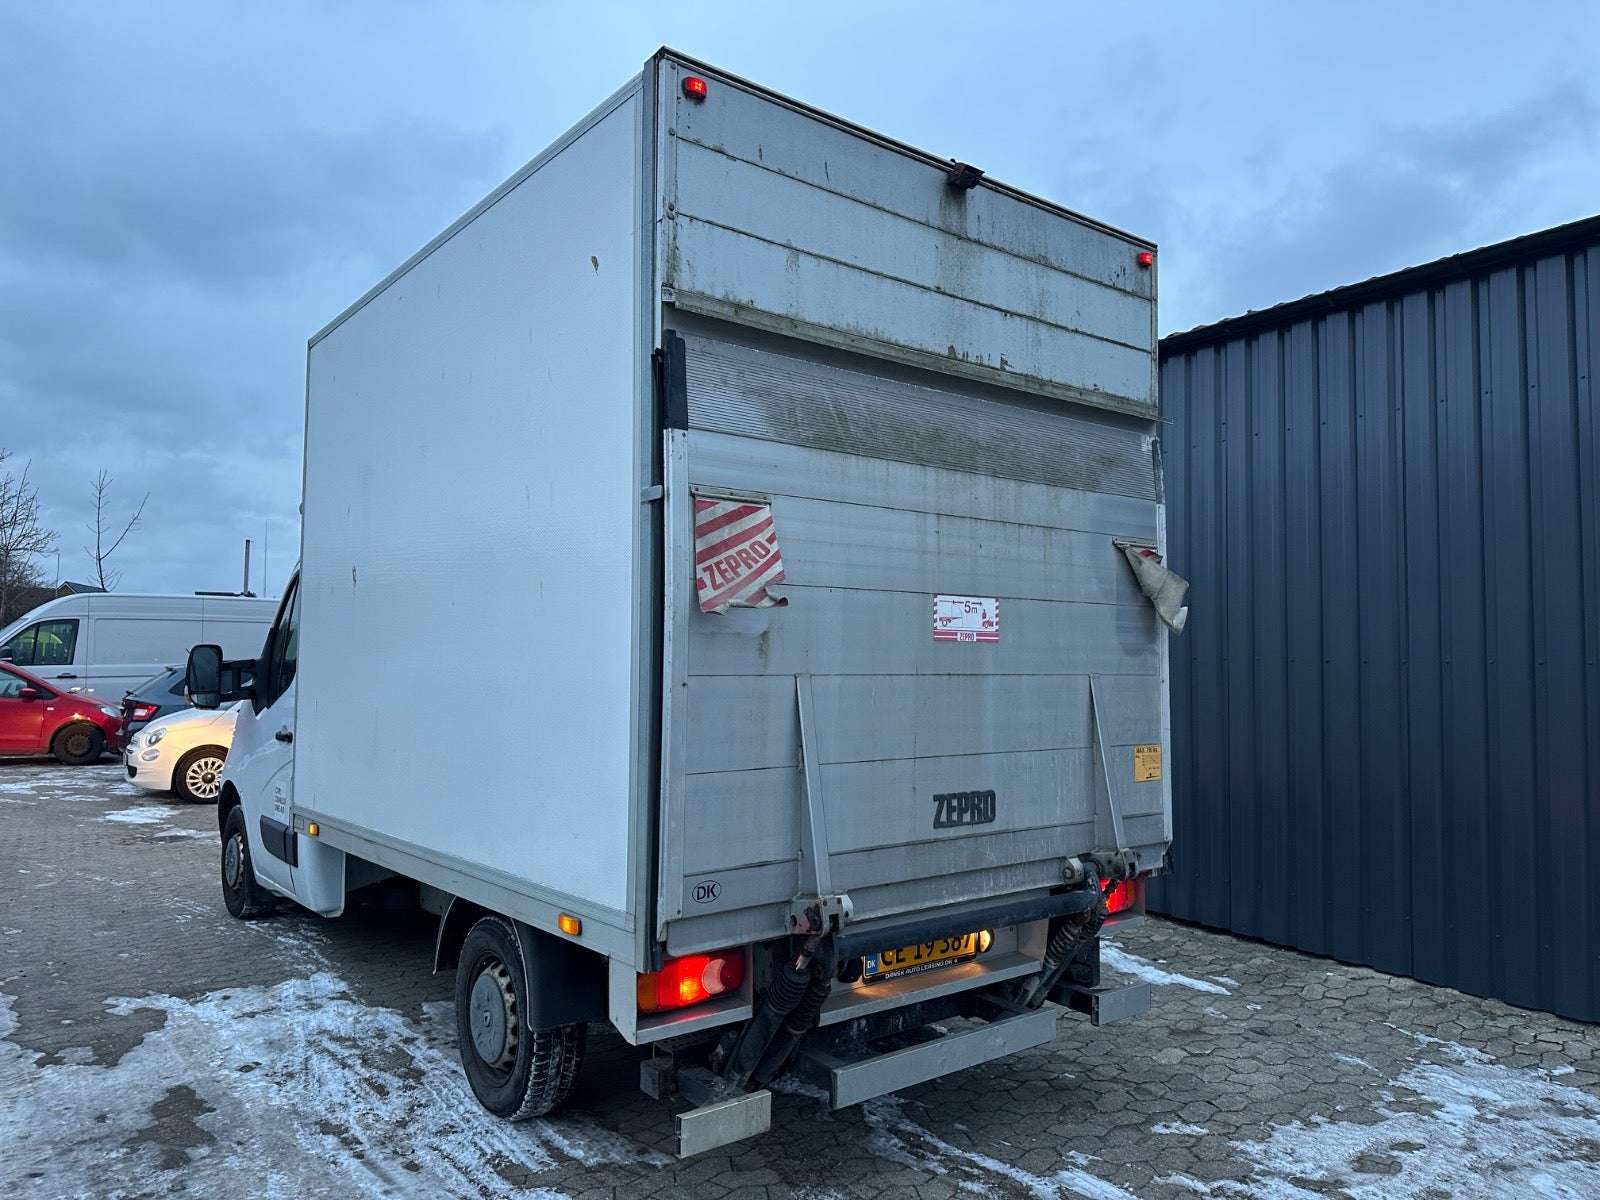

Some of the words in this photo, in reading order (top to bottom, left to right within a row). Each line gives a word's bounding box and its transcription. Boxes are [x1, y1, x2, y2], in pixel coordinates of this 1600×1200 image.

[702, 539, 771, 591] ZEPRO
[959, 632, 975, 641] ZEPRO
[933, 790, 996, 829] ZEPRO
[697, 883, 717, 900] DK
[867, 960, 876, 969] DK
[885, 970, 905, 979] DANSK
[905, 966, 921, 975] AUTO
